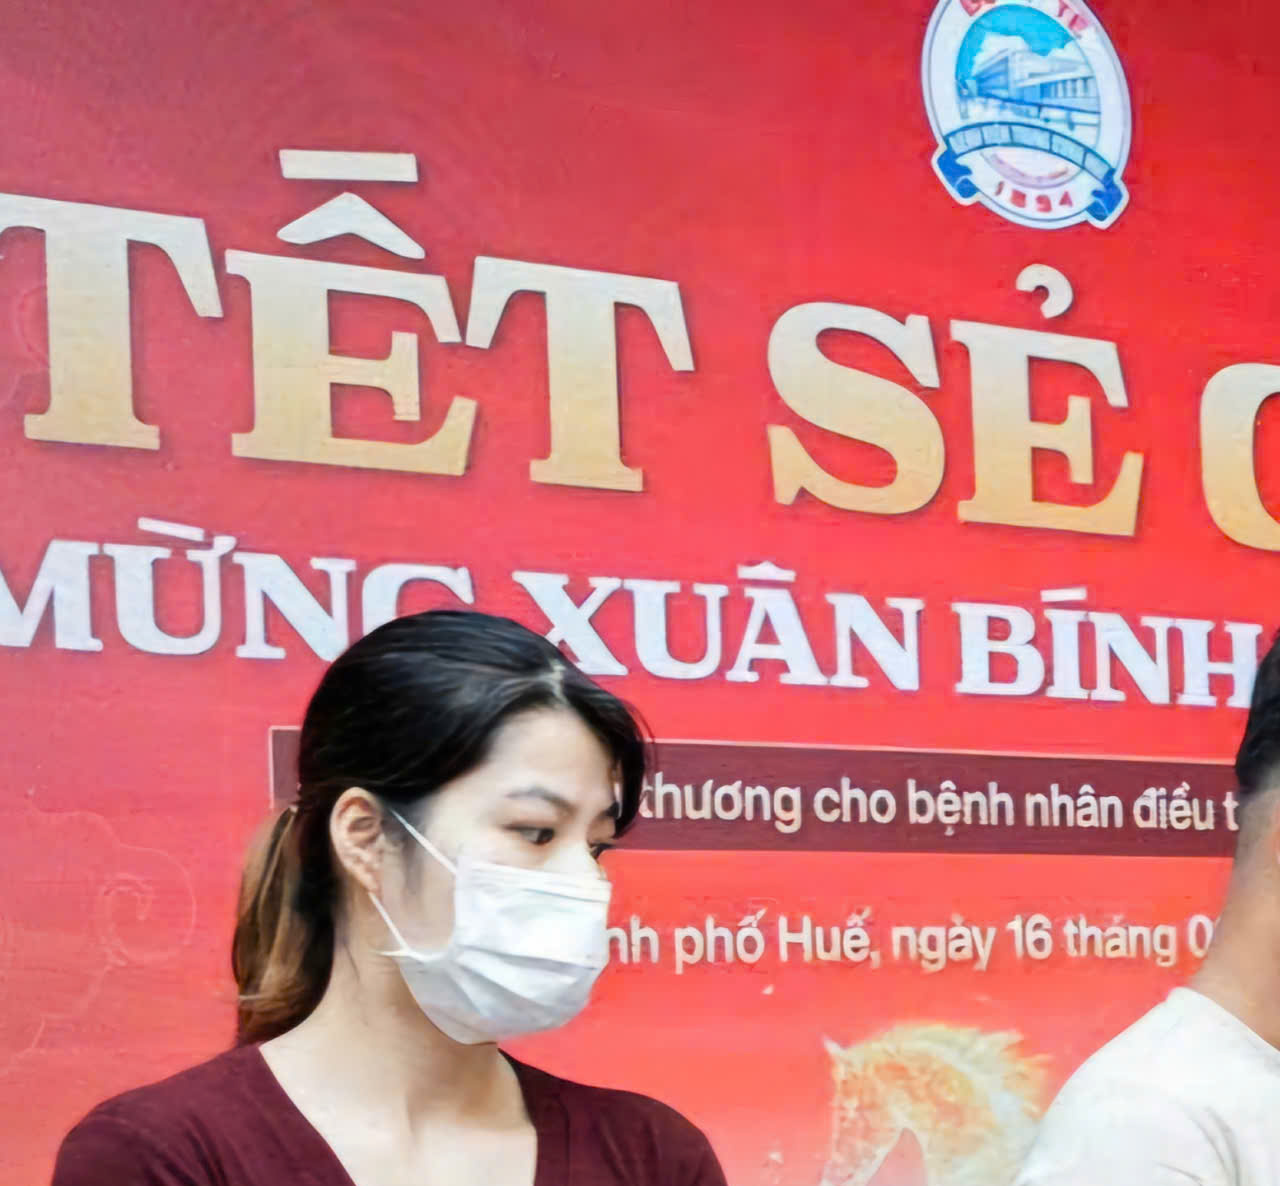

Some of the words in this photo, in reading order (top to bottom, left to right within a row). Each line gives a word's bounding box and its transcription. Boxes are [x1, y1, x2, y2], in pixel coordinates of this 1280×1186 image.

[767, 263, 1144, 536] SẺ
[512, 561, 924, 691] XUÂN
[951, 587, 1262, 709] BÍNH
[813, 776, 896, 824] cho
[907, 778, 1014, 836] bệnh
[1025, 783, 1124, 828] nhân
[1133, 781, 1215, 830] điều
[674, 907, 766, 975] phố
[778, 906, 880, 969] Huế,
[891, 912, 997, 973] ngày
[1006, 913, 1052, 960] 16
[1063, 912, 1177, 967] tháng
